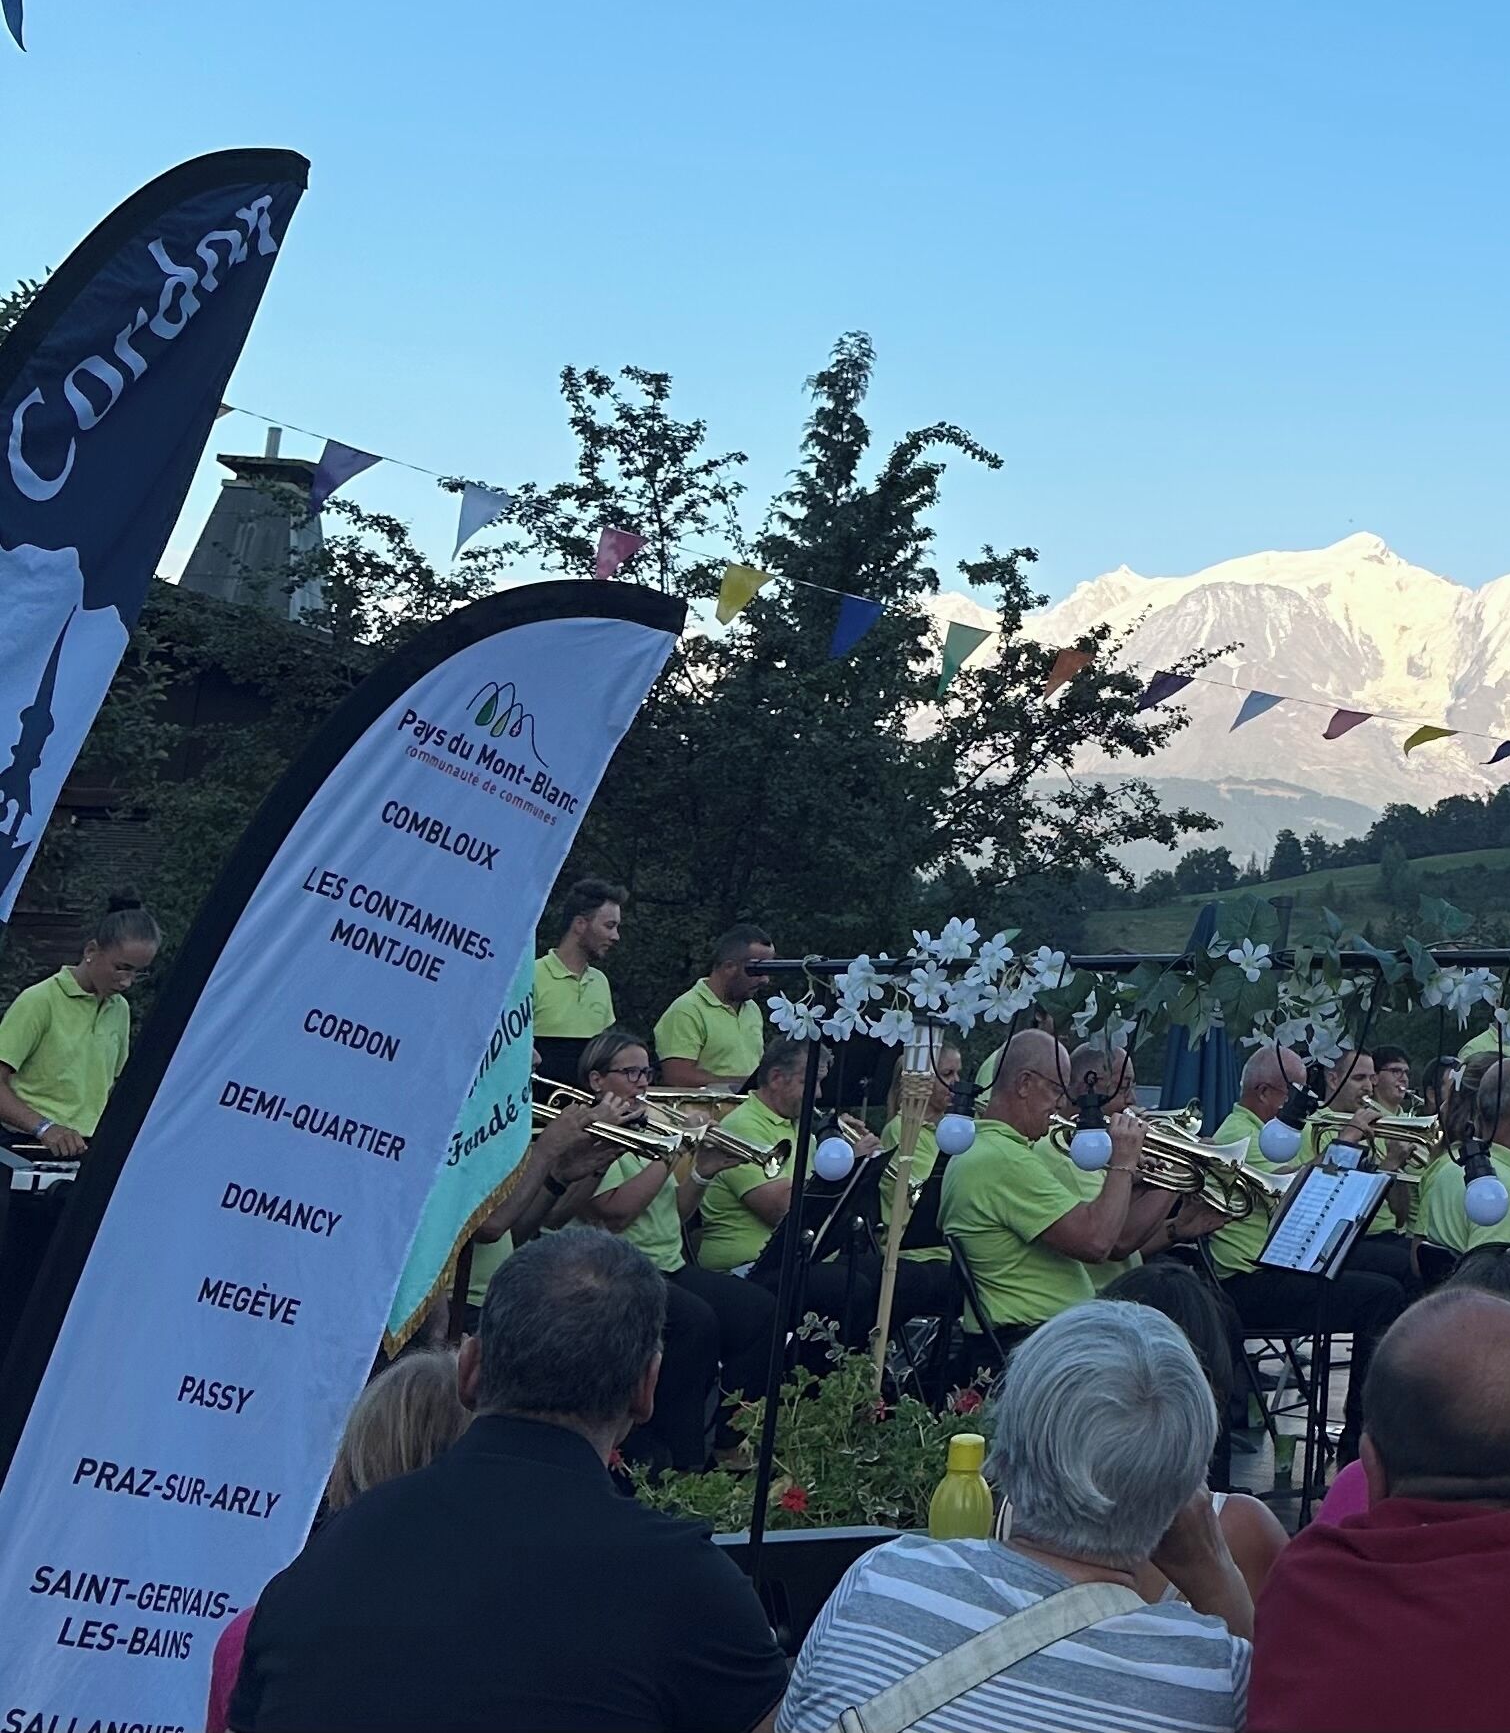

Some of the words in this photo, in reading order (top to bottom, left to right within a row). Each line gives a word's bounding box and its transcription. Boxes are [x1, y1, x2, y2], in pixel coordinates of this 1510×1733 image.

[397, 708, 448, 746] Pays
[447, 733, 475, 760] du
[475, 743, 579, 815] Mont-Blanc
[404, 744, 480, 786] communauté
[481, 779, 497, 795] de
[499, 788, 557, 827] communes
[381, 800, 501, 871] COMBLOUX
[302, 866, 348, 900] LES
[349, 884, 495, 960] CONTAMINES-
[329, 918, 446, 982] MONTJOIE
[303, 1008, 400, 1062] CORDON
[218, 1080, 406, 1162] DEMI-QUARTIER
[446, 1093, 519, 1167] Fondé
[220, 1182, 343, 1237] DOMANCY
[197, 1276, 301, 1326] MEGÈVE
[177, 1374, 255, 1415] PASSY
[72, 1457, 282, 1519] PRAZ-SUR-ARLY
[29, 1565, 240, 1619] SAINT-GERVAIS-
[56, 1616, 194, 1661] LES-BAINS
